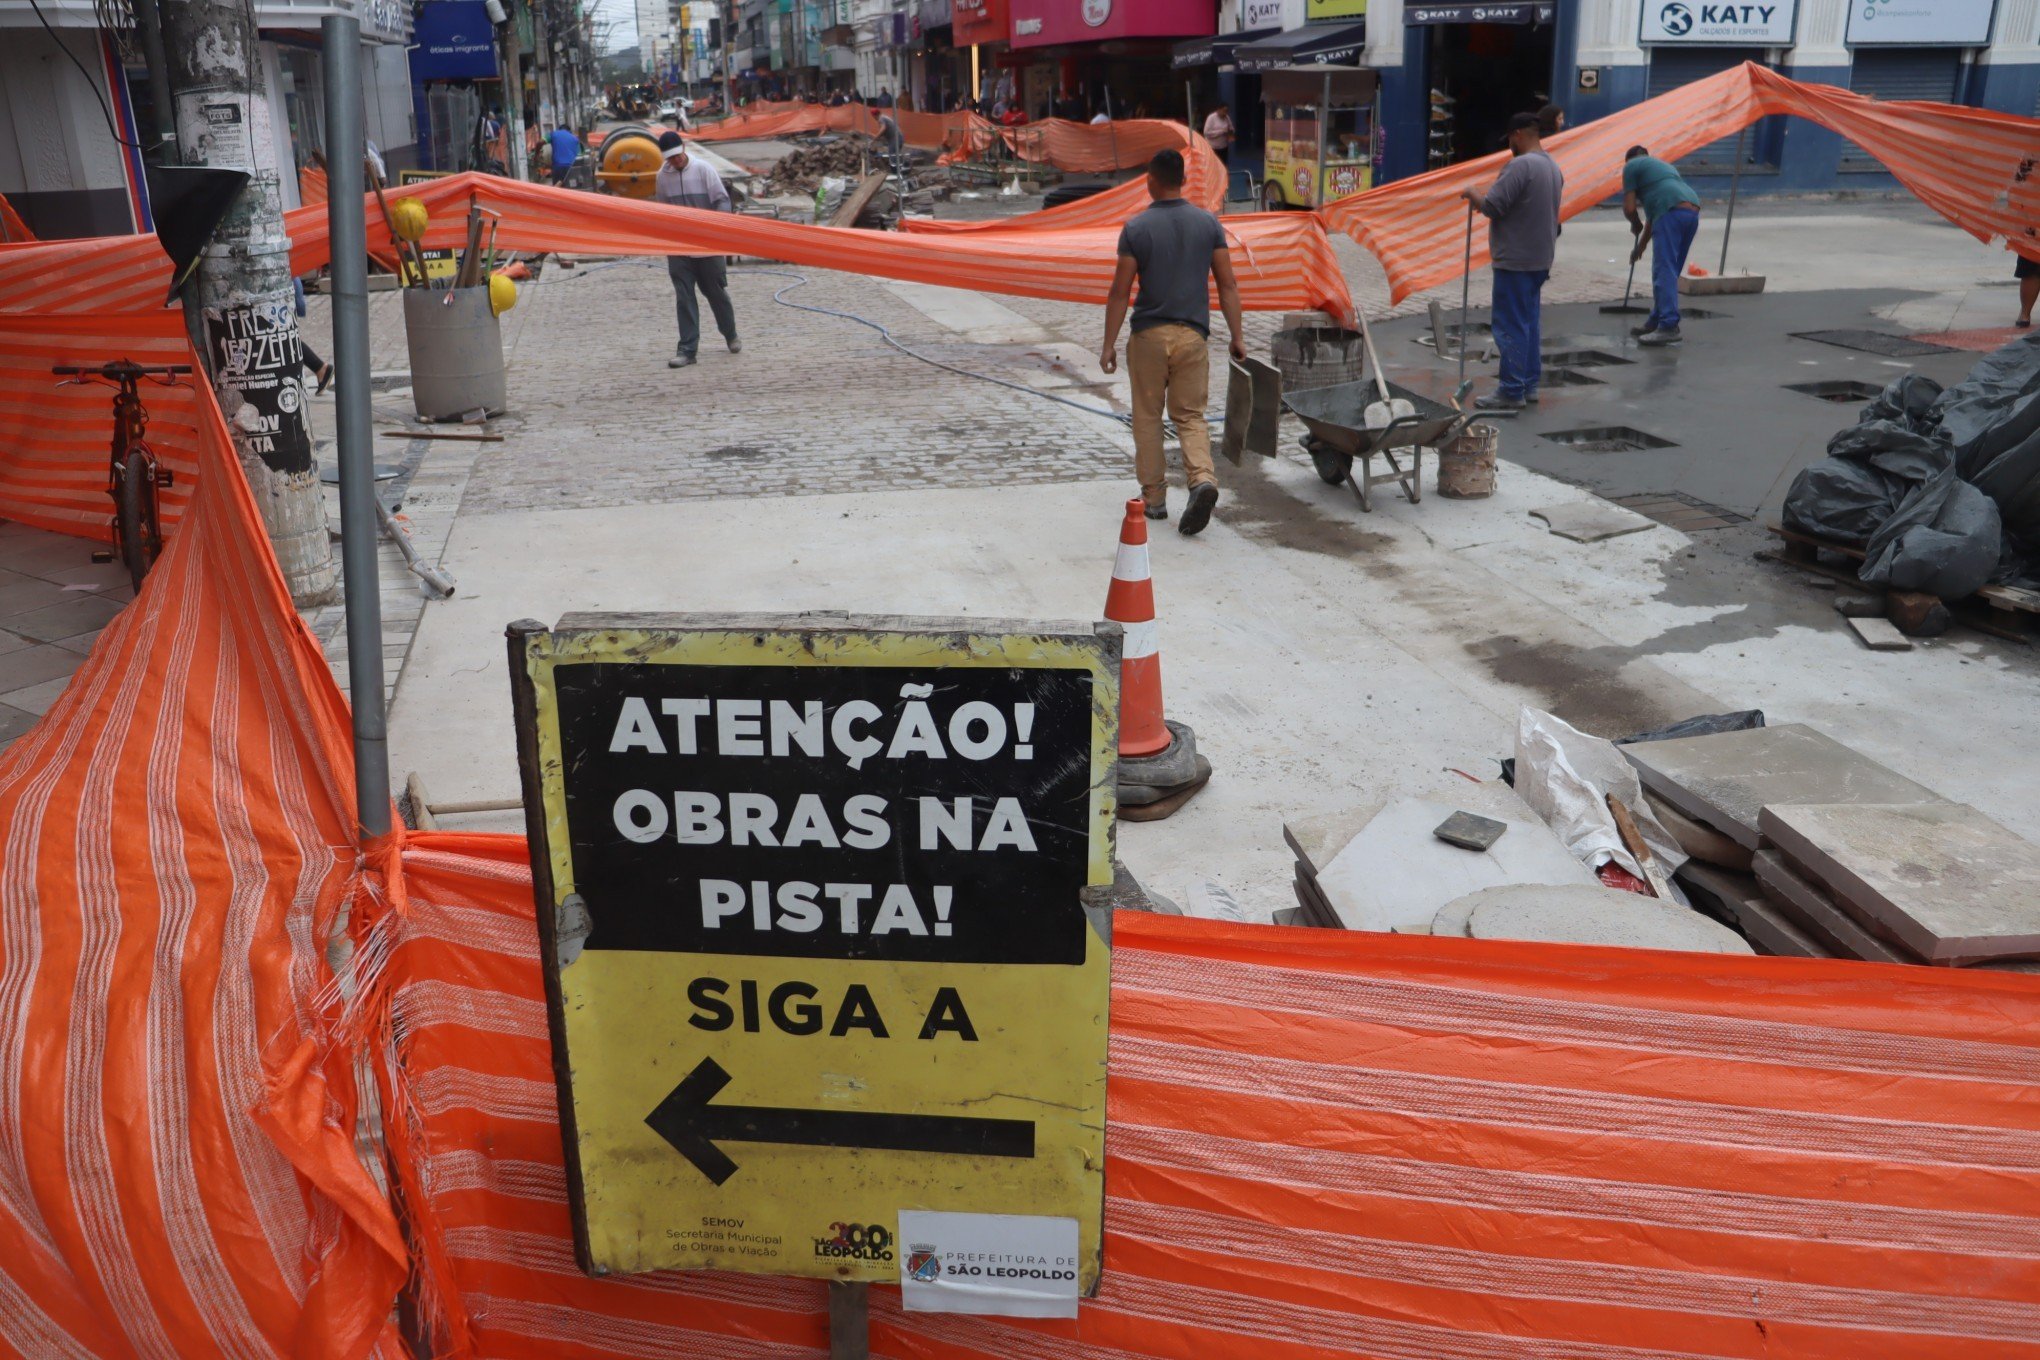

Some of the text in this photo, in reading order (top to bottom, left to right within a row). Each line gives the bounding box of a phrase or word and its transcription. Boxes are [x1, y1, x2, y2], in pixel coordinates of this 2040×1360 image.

[1259, 4, 1280, 16] KATY
[1429, 10, 1461, 18] KATY
[1487, 9, 1519, 17] KATY
[1700, 5, 1776, 24] KATY
[454, 44, 490, 54] imigrante
[1326, 50, 1354, 60] KATY
[248, 379, 279, 389] Hunger
[609, 683, 1035, 770] ATENÇÃO!
[613, 788, 1038, 851] OBRAS NA
[700, 879, 953, 936] PISTA!
[687, 977, 979, 1041] SIGA A
[702, 1217, 744, 1228] SEMOV
[666, 1229, 782, 1244] Secretaria Municipal
[672, 1241, 687, 1251] de
[690, 1242, 725, 1253] Obras
[740, 1246, 778, 1257] Viação
[814, 1245, 894, 1261] LEOPOLDO
[946, 1252, 1076, 1266] PREFEITURA DE
[947, 1263, 1076, 1281] SÃO LEOPOLDO
